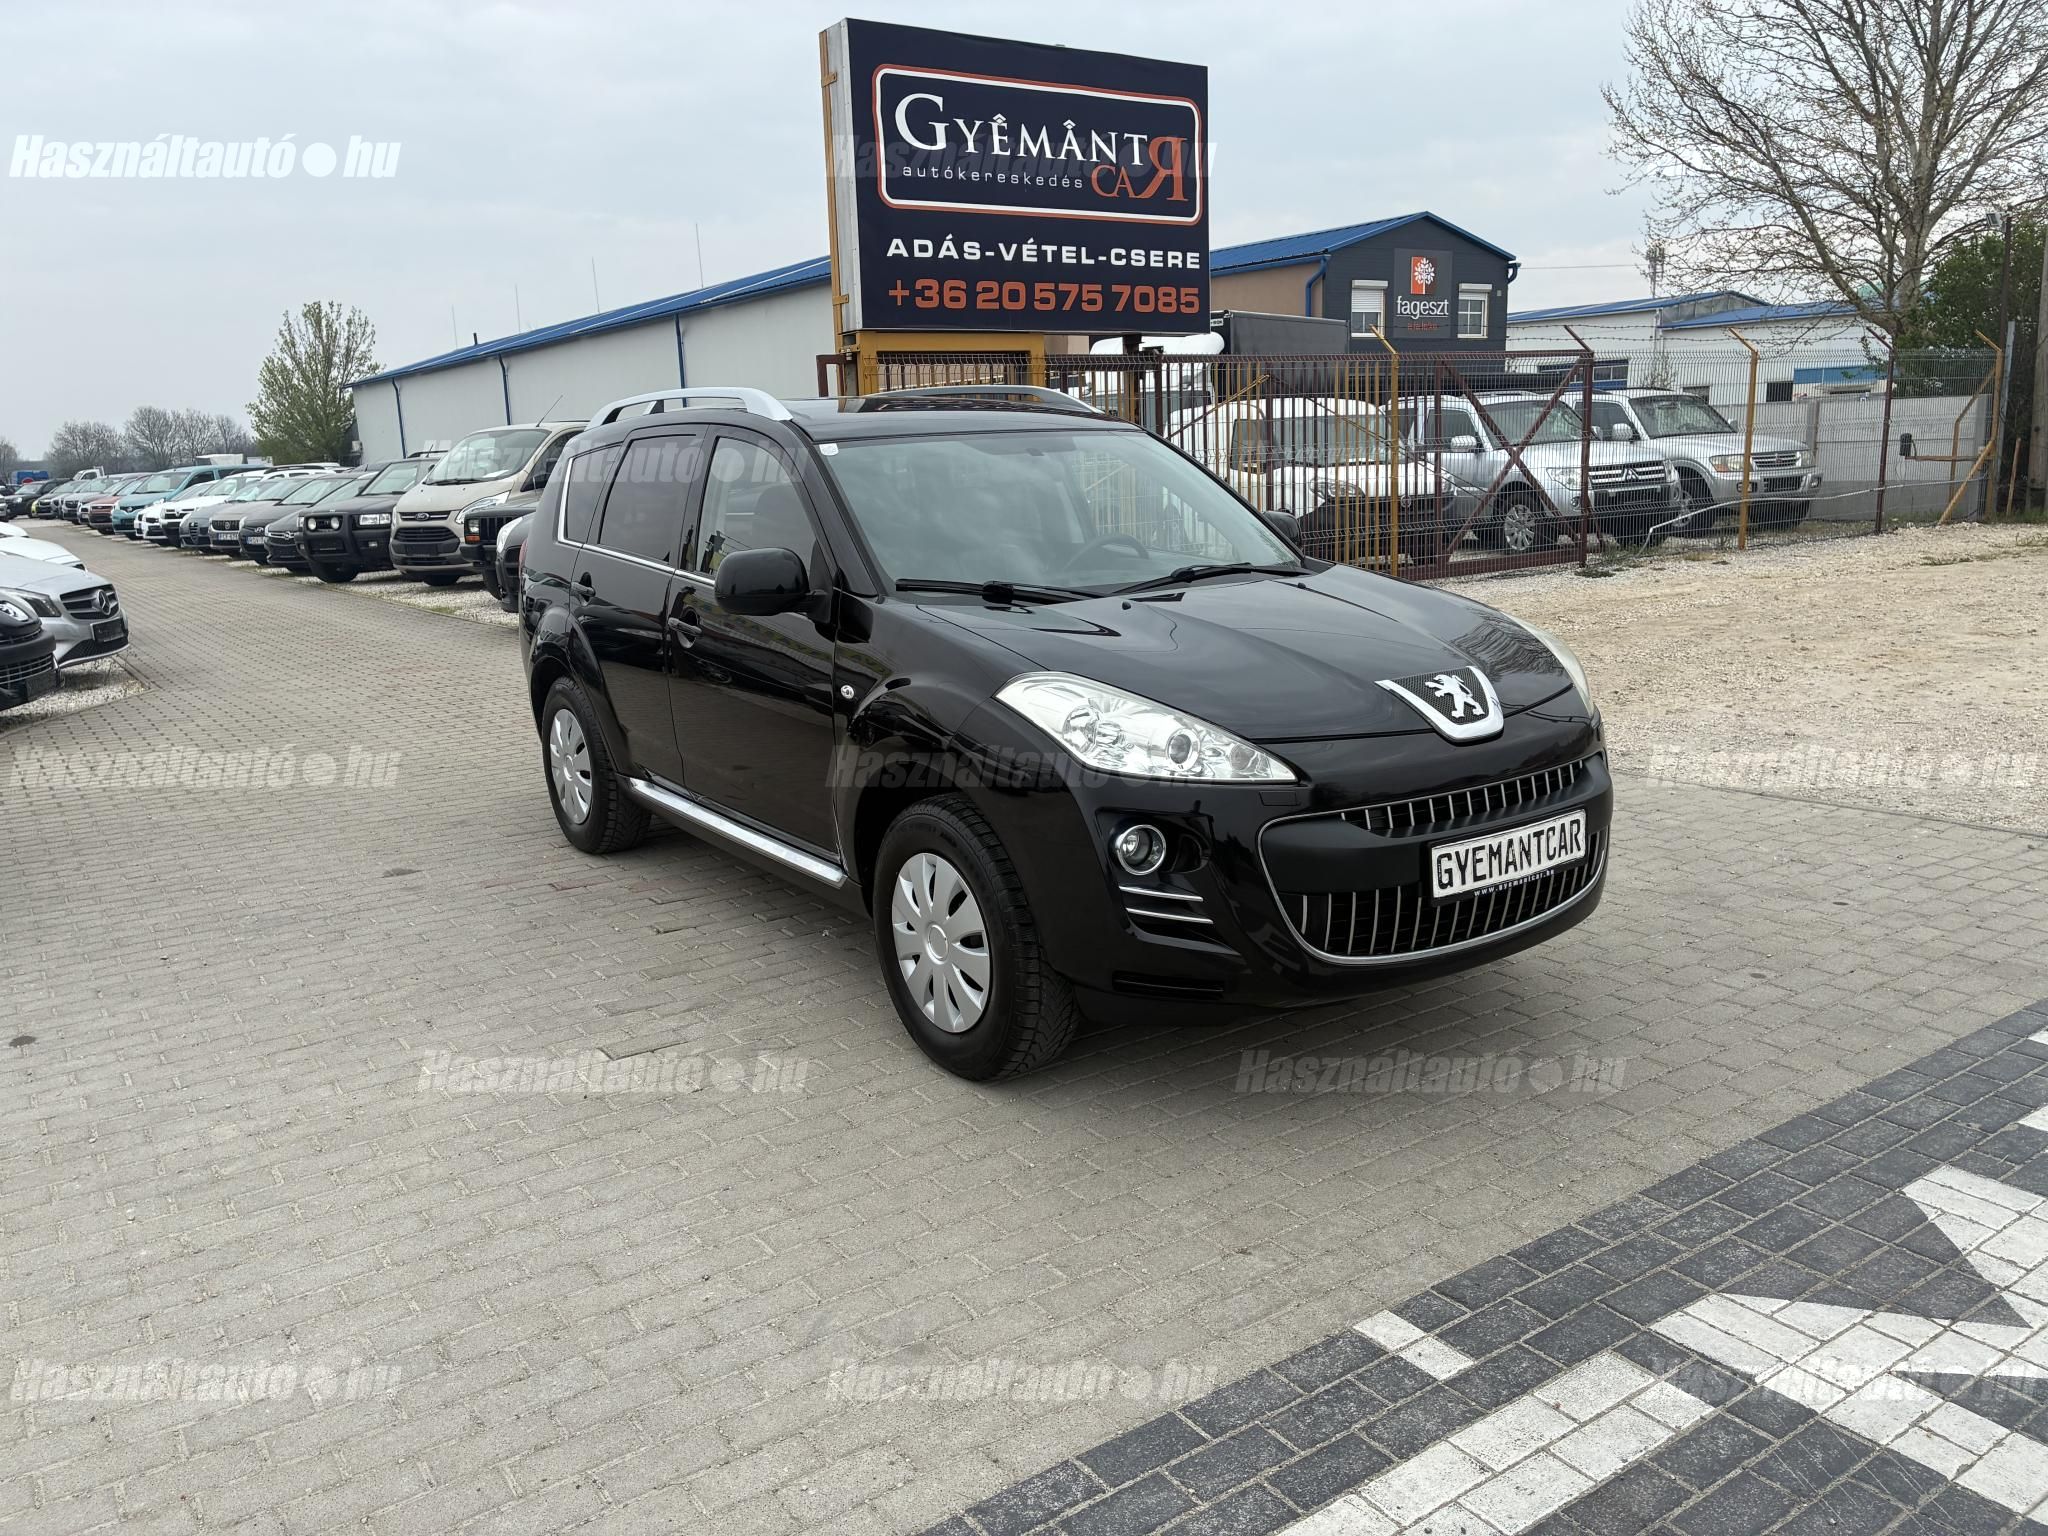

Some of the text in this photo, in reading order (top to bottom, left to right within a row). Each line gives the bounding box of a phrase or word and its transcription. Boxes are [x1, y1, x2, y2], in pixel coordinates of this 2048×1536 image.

[902, 164, 1083, 189] autókereskedés
[1091, 136, 1189, 202] CAR
[886, 233, 1201, 270] ADÁS-VÉTEL-CSERE
[888, 278, 1201, 315] +36 20 575 7085
[1396, 295, 1449, 320] fageszt
[1436, 818, 1582, 890] GYEMANTCAR
